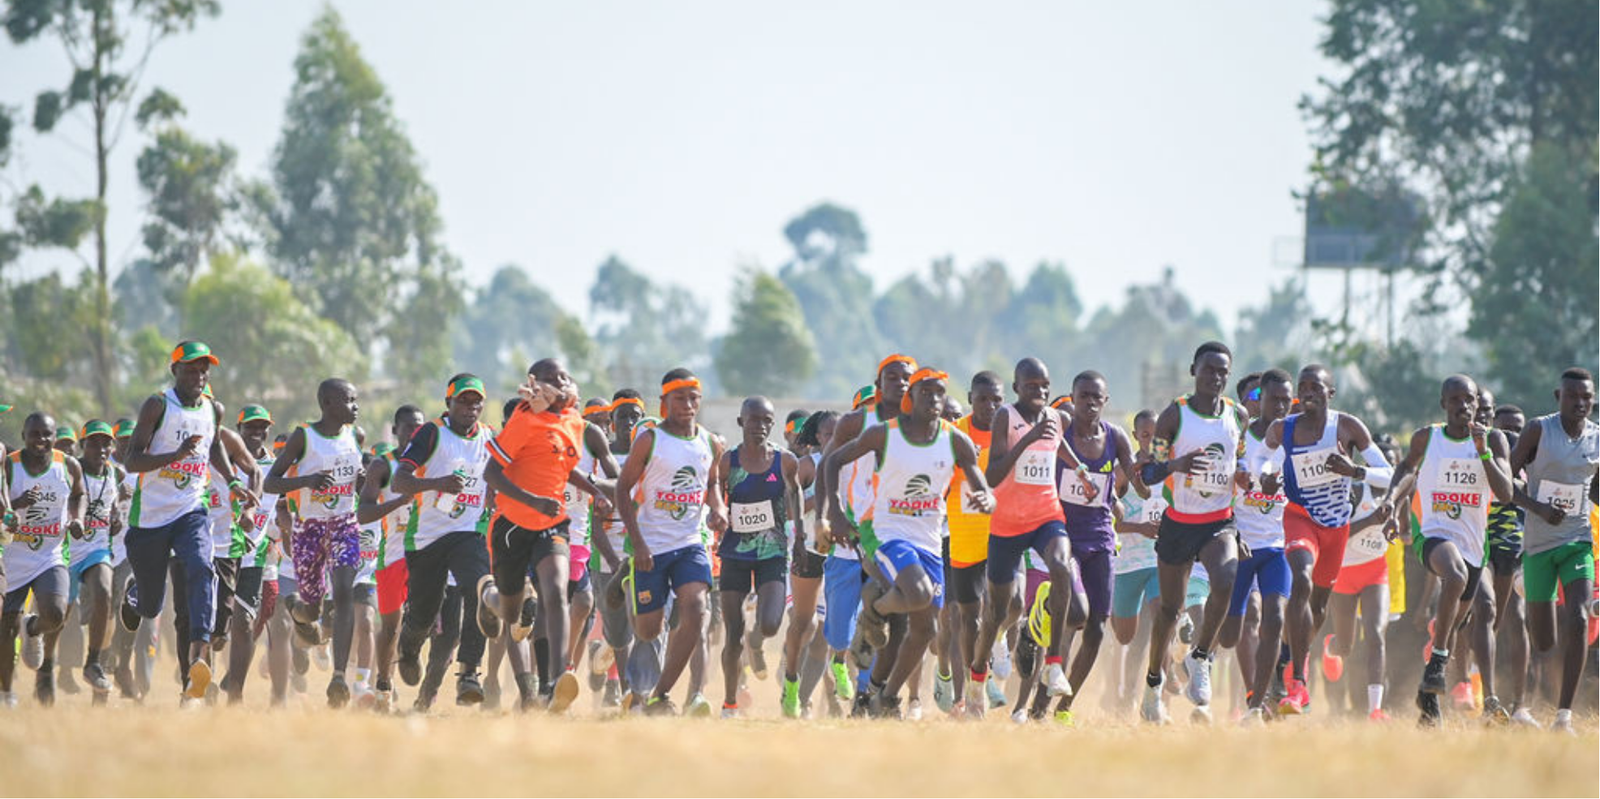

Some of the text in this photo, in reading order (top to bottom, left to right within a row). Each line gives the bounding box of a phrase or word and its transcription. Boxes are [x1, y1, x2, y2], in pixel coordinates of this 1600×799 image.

[176, 430, 190, 440] 10
[1023, 465, 1050, 477] 1011
[1445, 472, 1477, 485] 1126
[37, 491, 57, 502] 045
[1071, 484, 1084, 496] 10
[656, 490, 701, 504] TOOKE
[889, 496, 941, 510] TOOKE
[1431, 491, 1481, 506] TOOKE
[738, 513, 767, 526] 1020
[21, 521, 60, 536] OOKE
